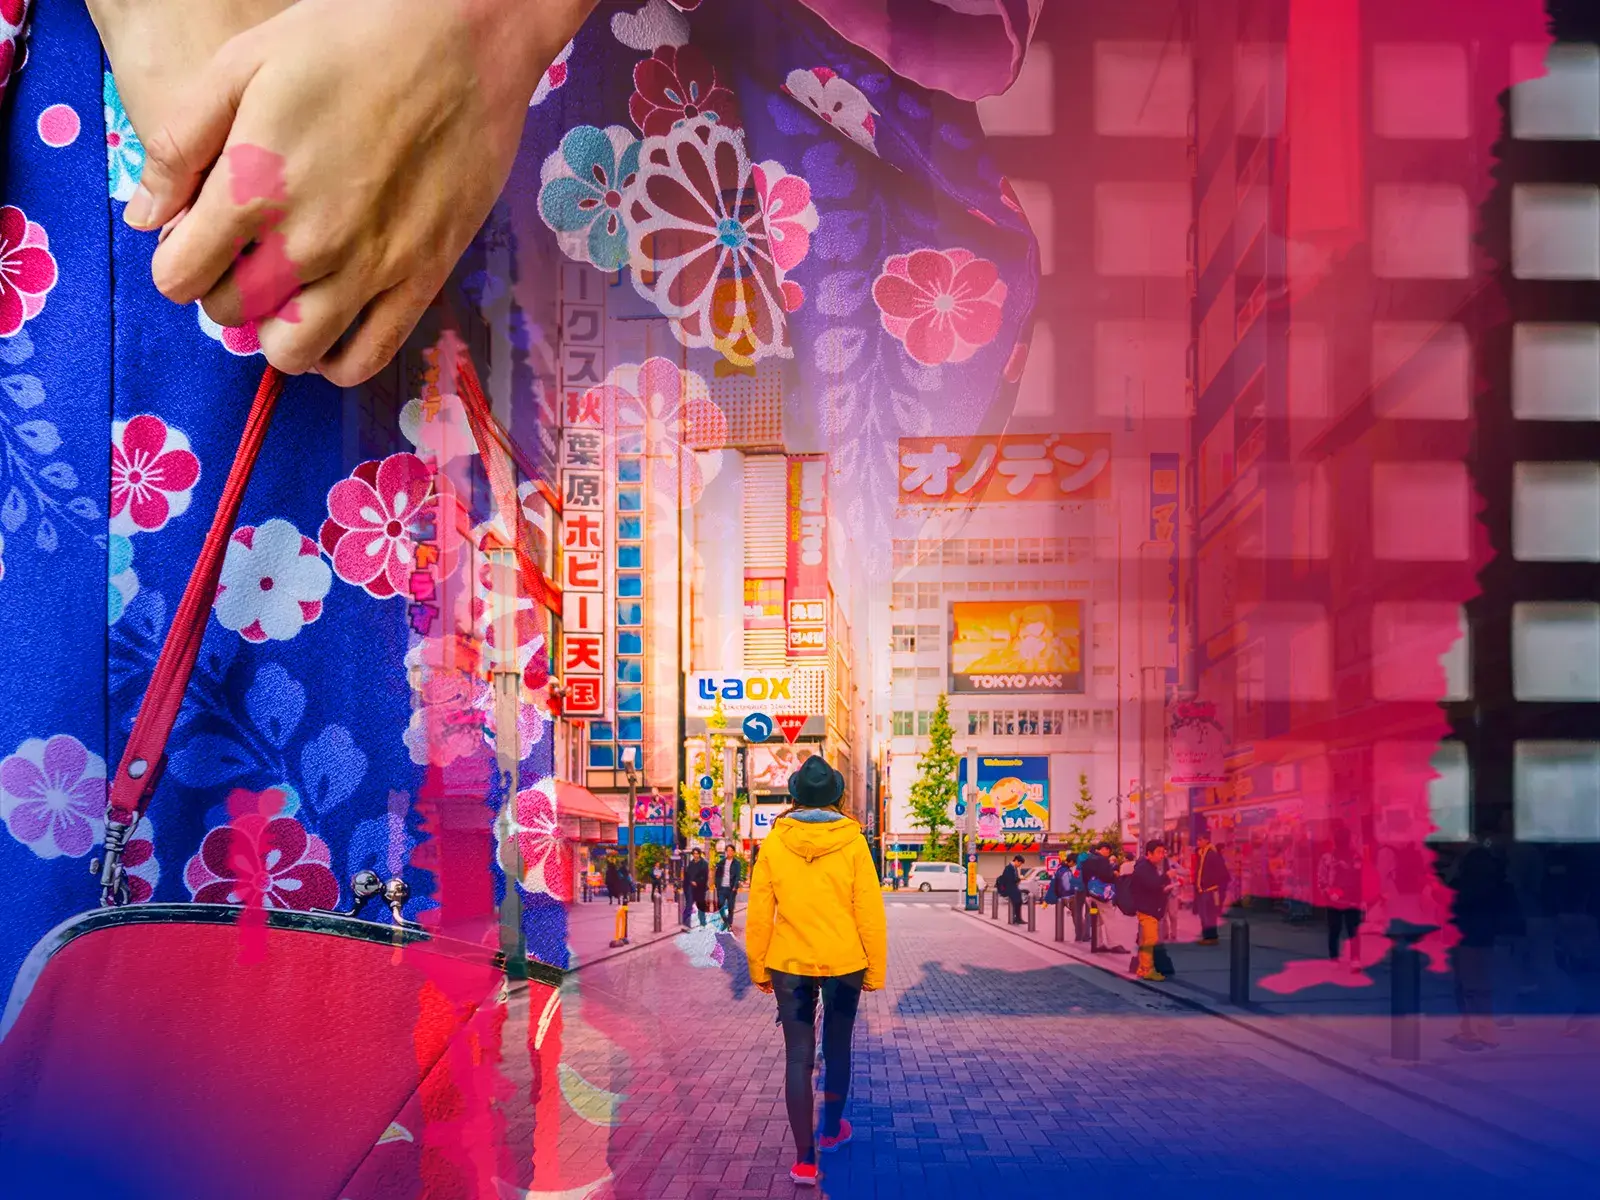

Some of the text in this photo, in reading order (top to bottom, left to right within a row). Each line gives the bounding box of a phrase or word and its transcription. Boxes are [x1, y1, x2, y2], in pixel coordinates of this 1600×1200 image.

[565, 236, 602, 713] ークス秋葉原ホビー天国
[901, 434, 1110, 495] オノデン
[969, 674, 1063, 689] TOKYO MX
